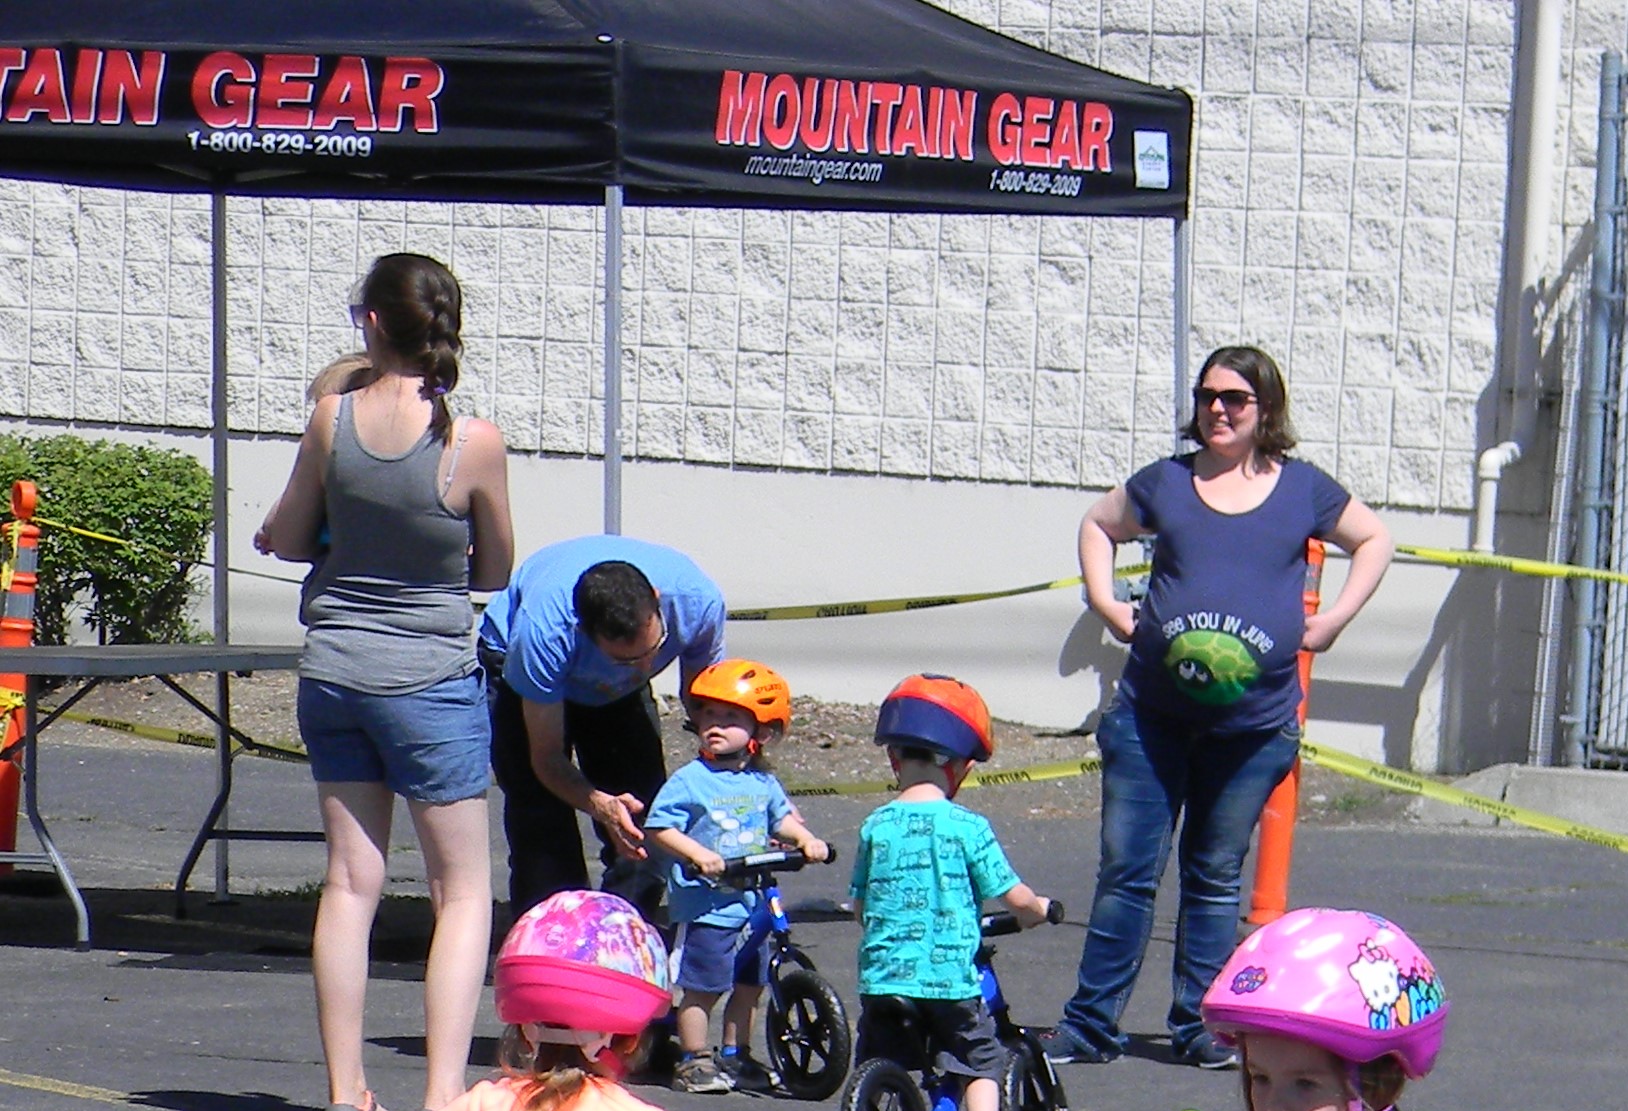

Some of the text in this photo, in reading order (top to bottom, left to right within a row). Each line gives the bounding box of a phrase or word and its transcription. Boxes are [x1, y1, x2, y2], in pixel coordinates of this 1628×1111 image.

[191, 50, 444, 134] GEAR
[715, 70, 1113, 173] MOUNTAIN GEAR
[187, 131, 372, 156] 1-800-829-2009
[744, 152, 882, 184] mountaingear.com
[988, 169, 1081, 196] 1-800-829-2009
[1187, 611, 1220, 630] YOU
[1223, 614, 1242, 634] IN
